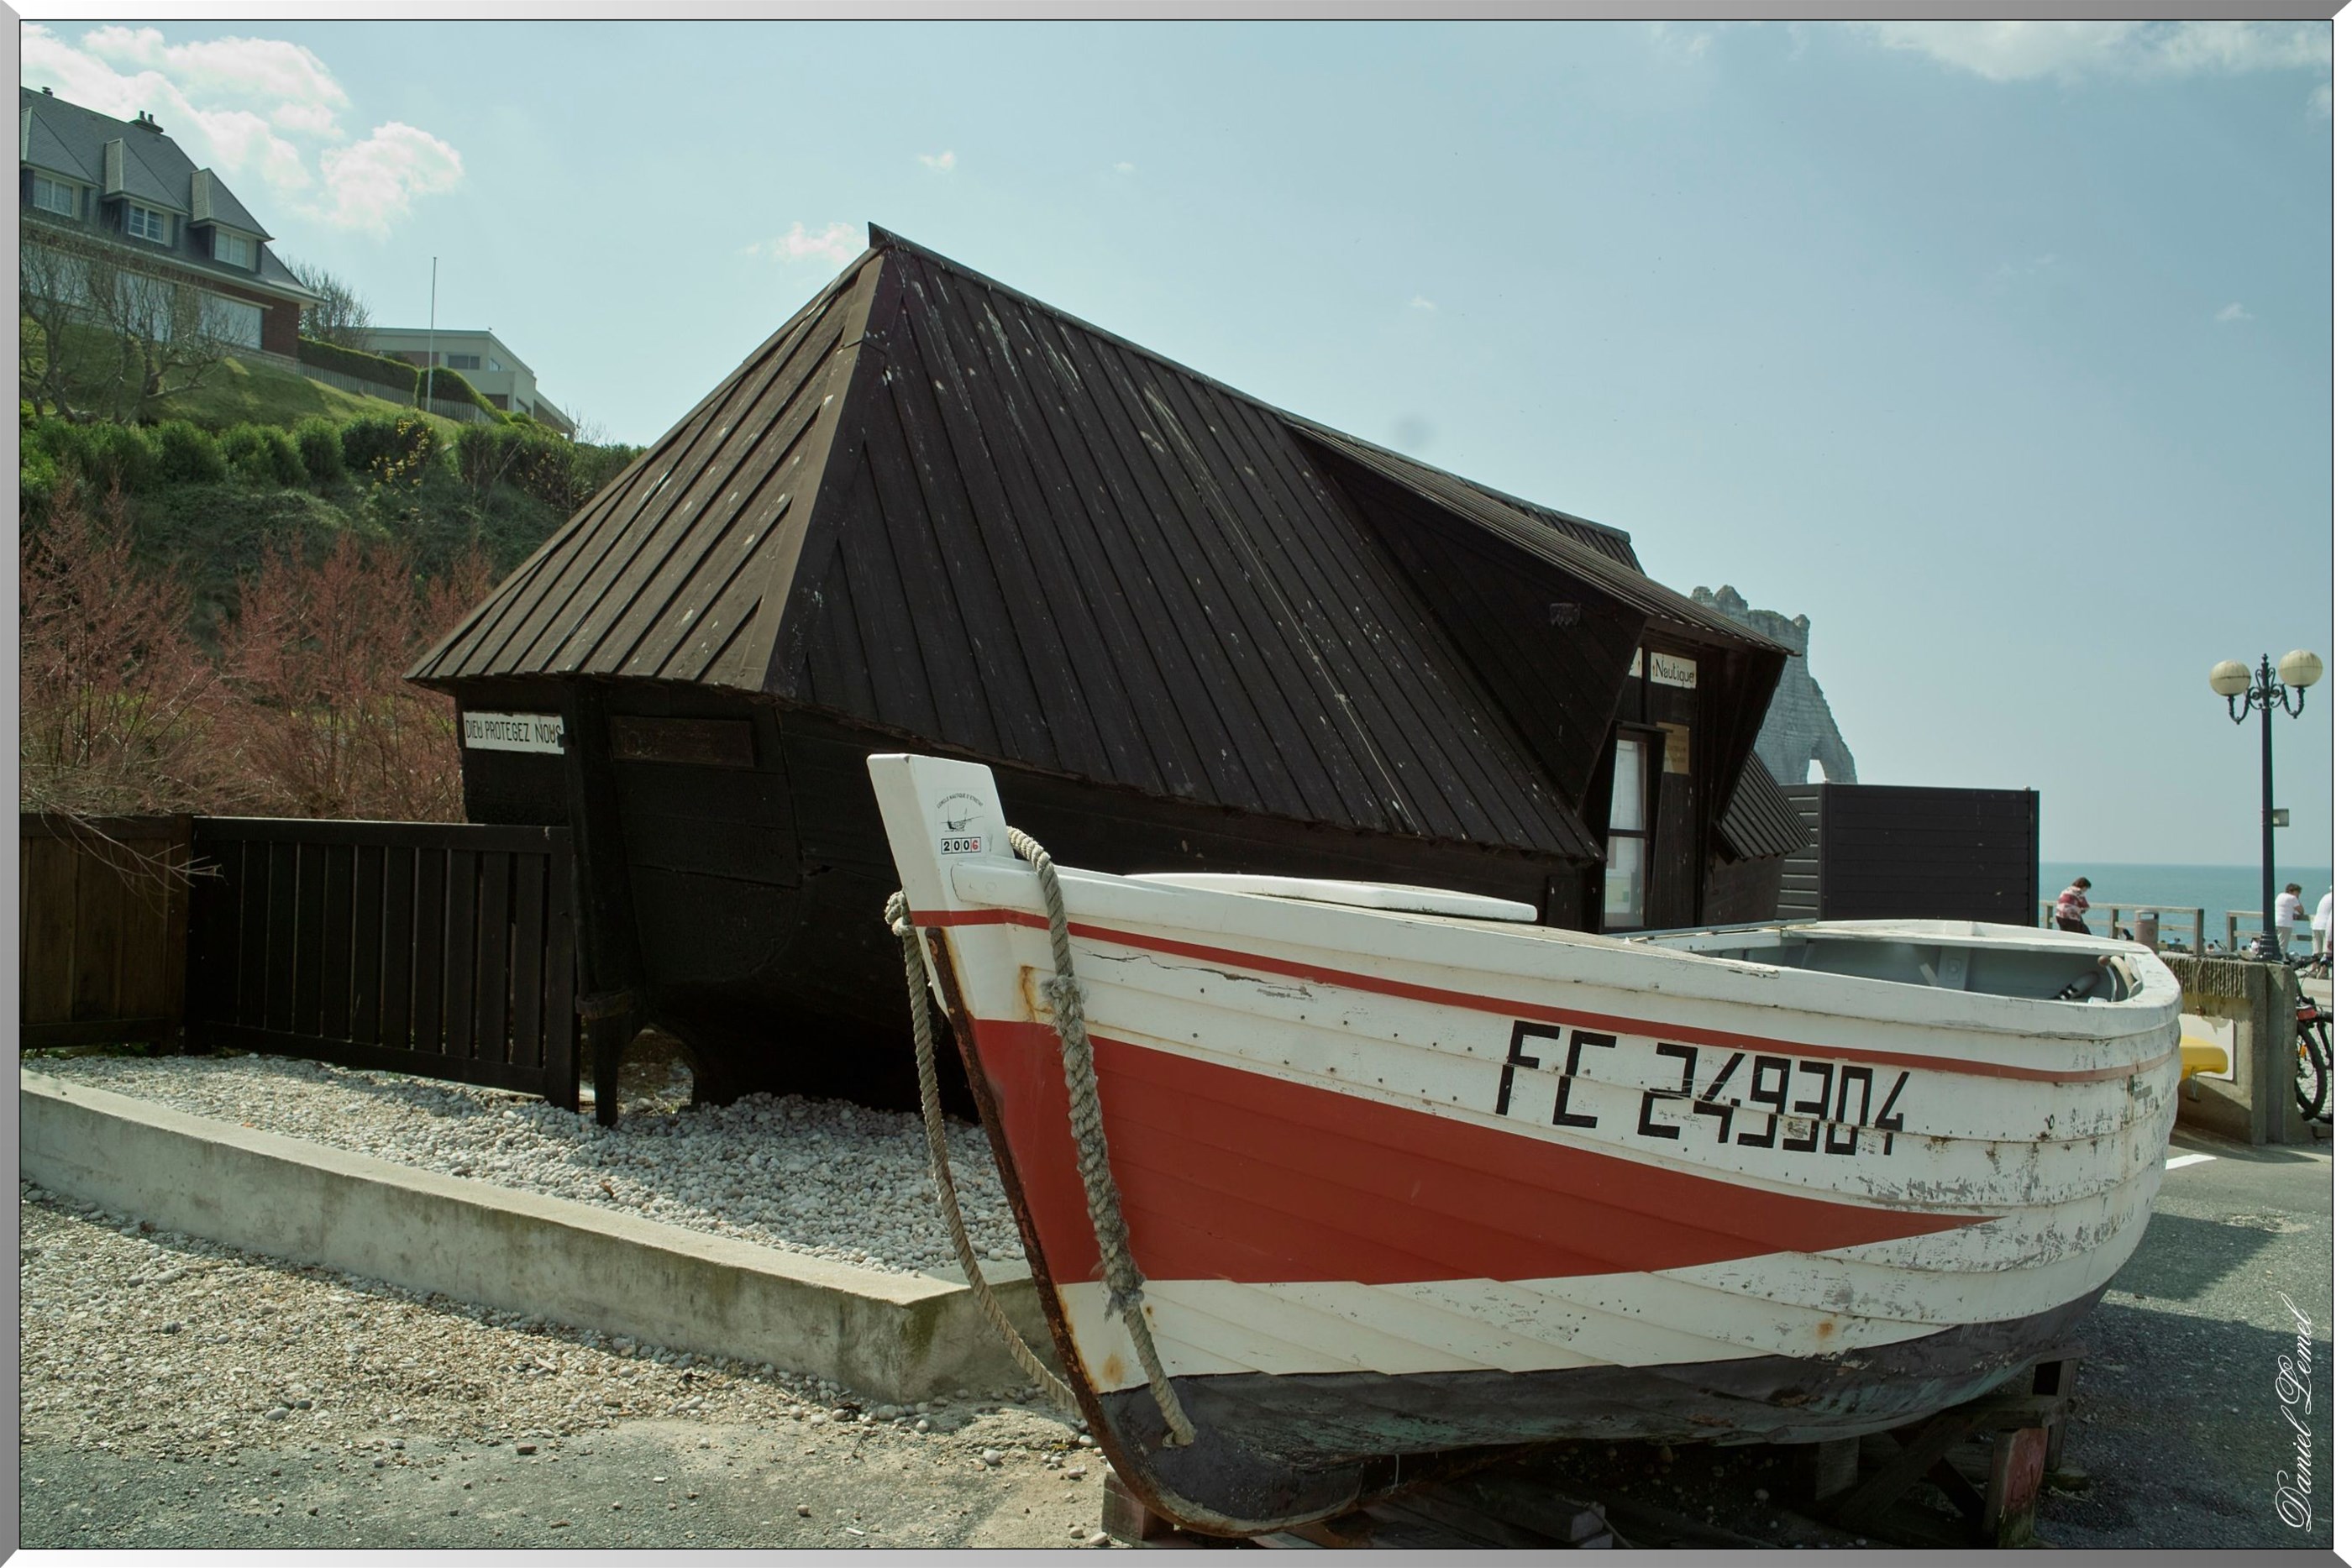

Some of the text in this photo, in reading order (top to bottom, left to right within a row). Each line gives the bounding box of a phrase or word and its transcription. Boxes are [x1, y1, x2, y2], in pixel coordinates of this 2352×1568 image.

[1656, 658, 1695, 686] Nautique
[465, 720, 483, 739] DIEU
[485, 721, 530, 742] PROTEGEZ
[943, 840, 979, 852] 2006
[1496, 1020, 1910, 1156] FC 249304
